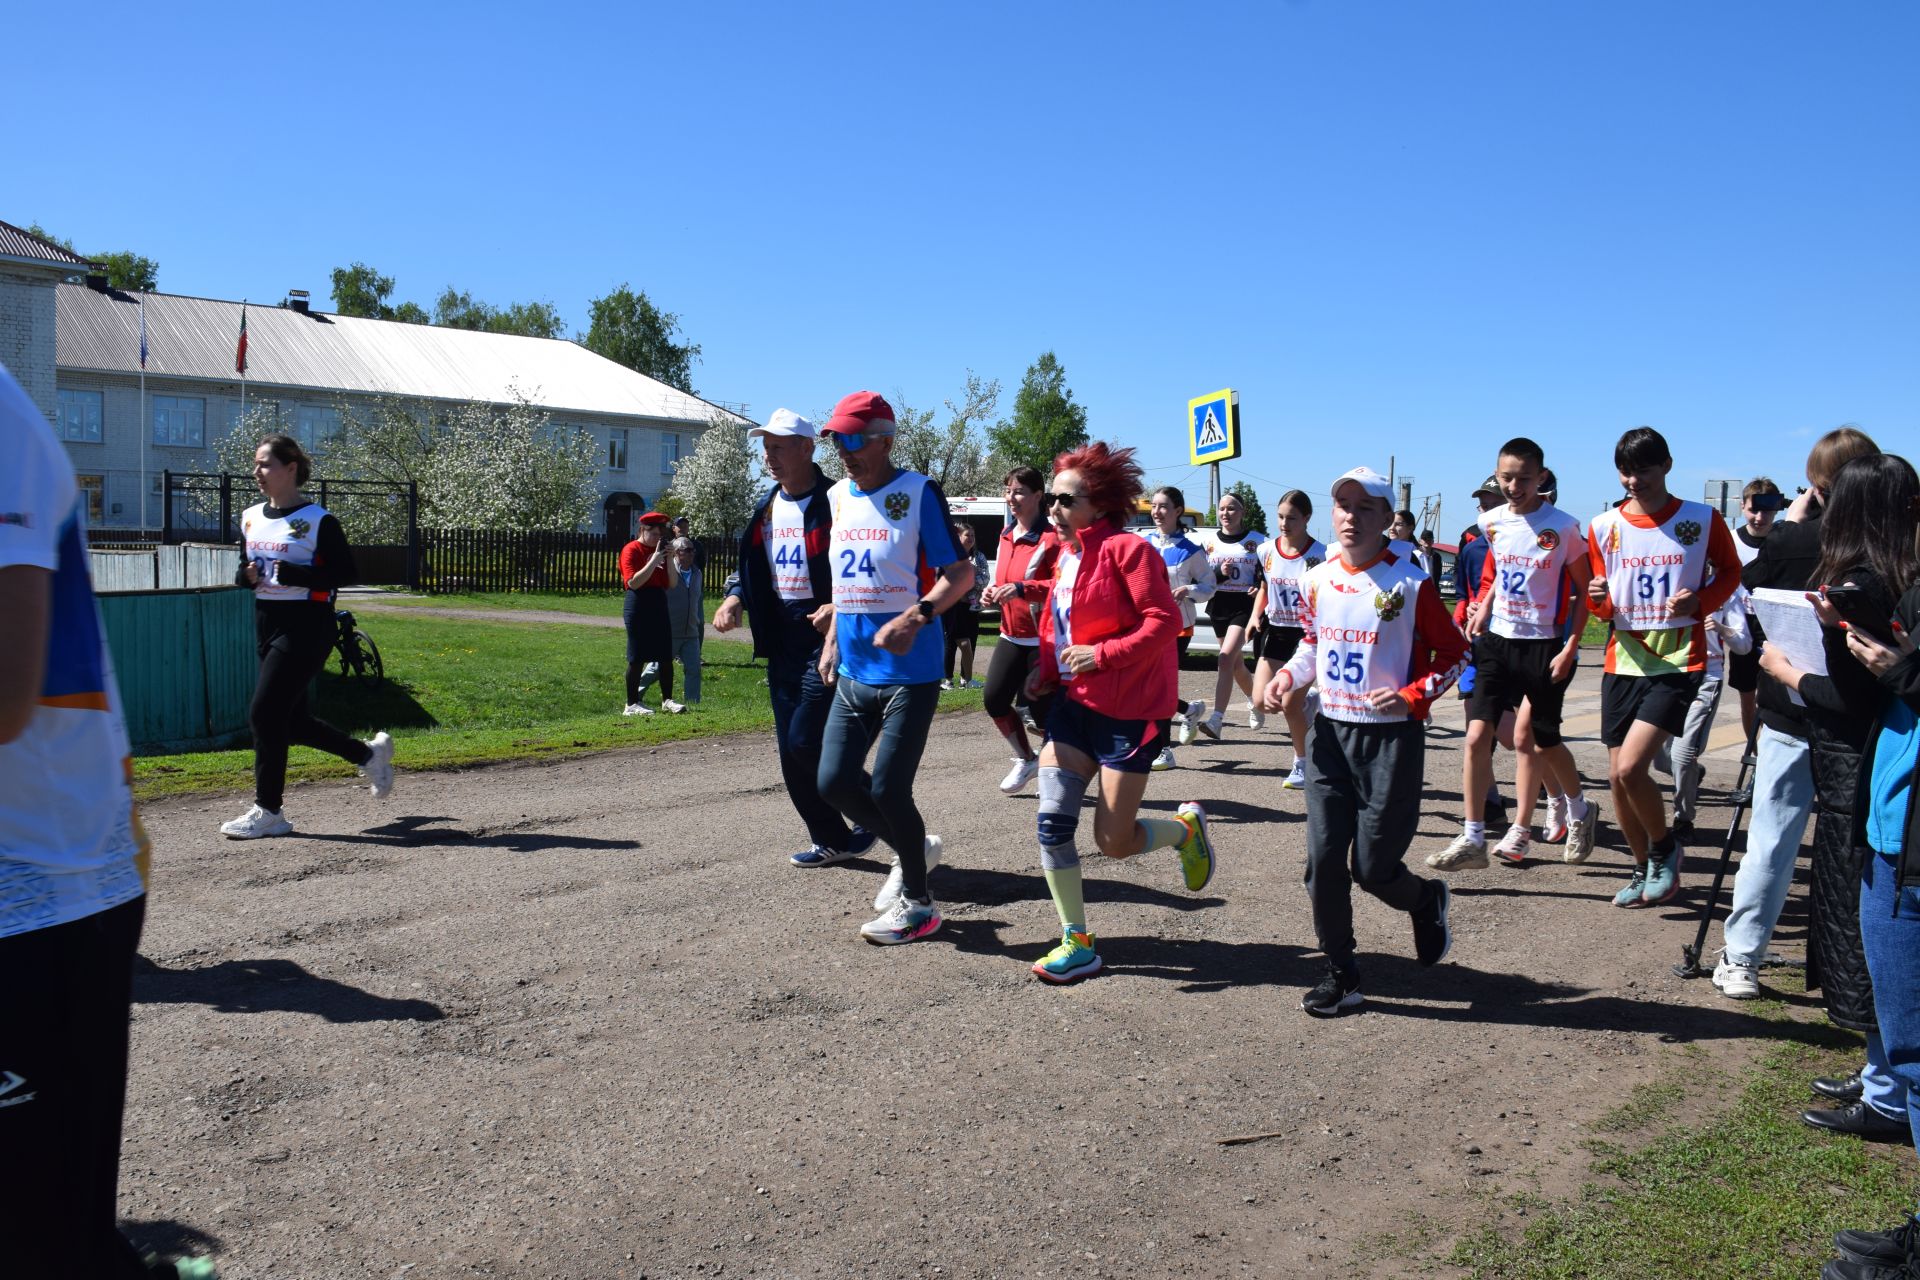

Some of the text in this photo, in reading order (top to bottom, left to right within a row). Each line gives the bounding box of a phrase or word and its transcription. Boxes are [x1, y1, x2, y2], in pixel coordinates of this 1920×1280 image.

[836, 528, 889, 542] РОССИЯ
[775, 544, 804, 569] 44
[840, 548, 875, 578] 24
[1621, 554, 1684, 569] РОССИЯ
[1637, 571, 1670, 599] 31
[1279, 589, 1300, 607] 12
[1320, 626, 1379, 645] РОССИЯ
[1327, 650, 1364, 684] 35
